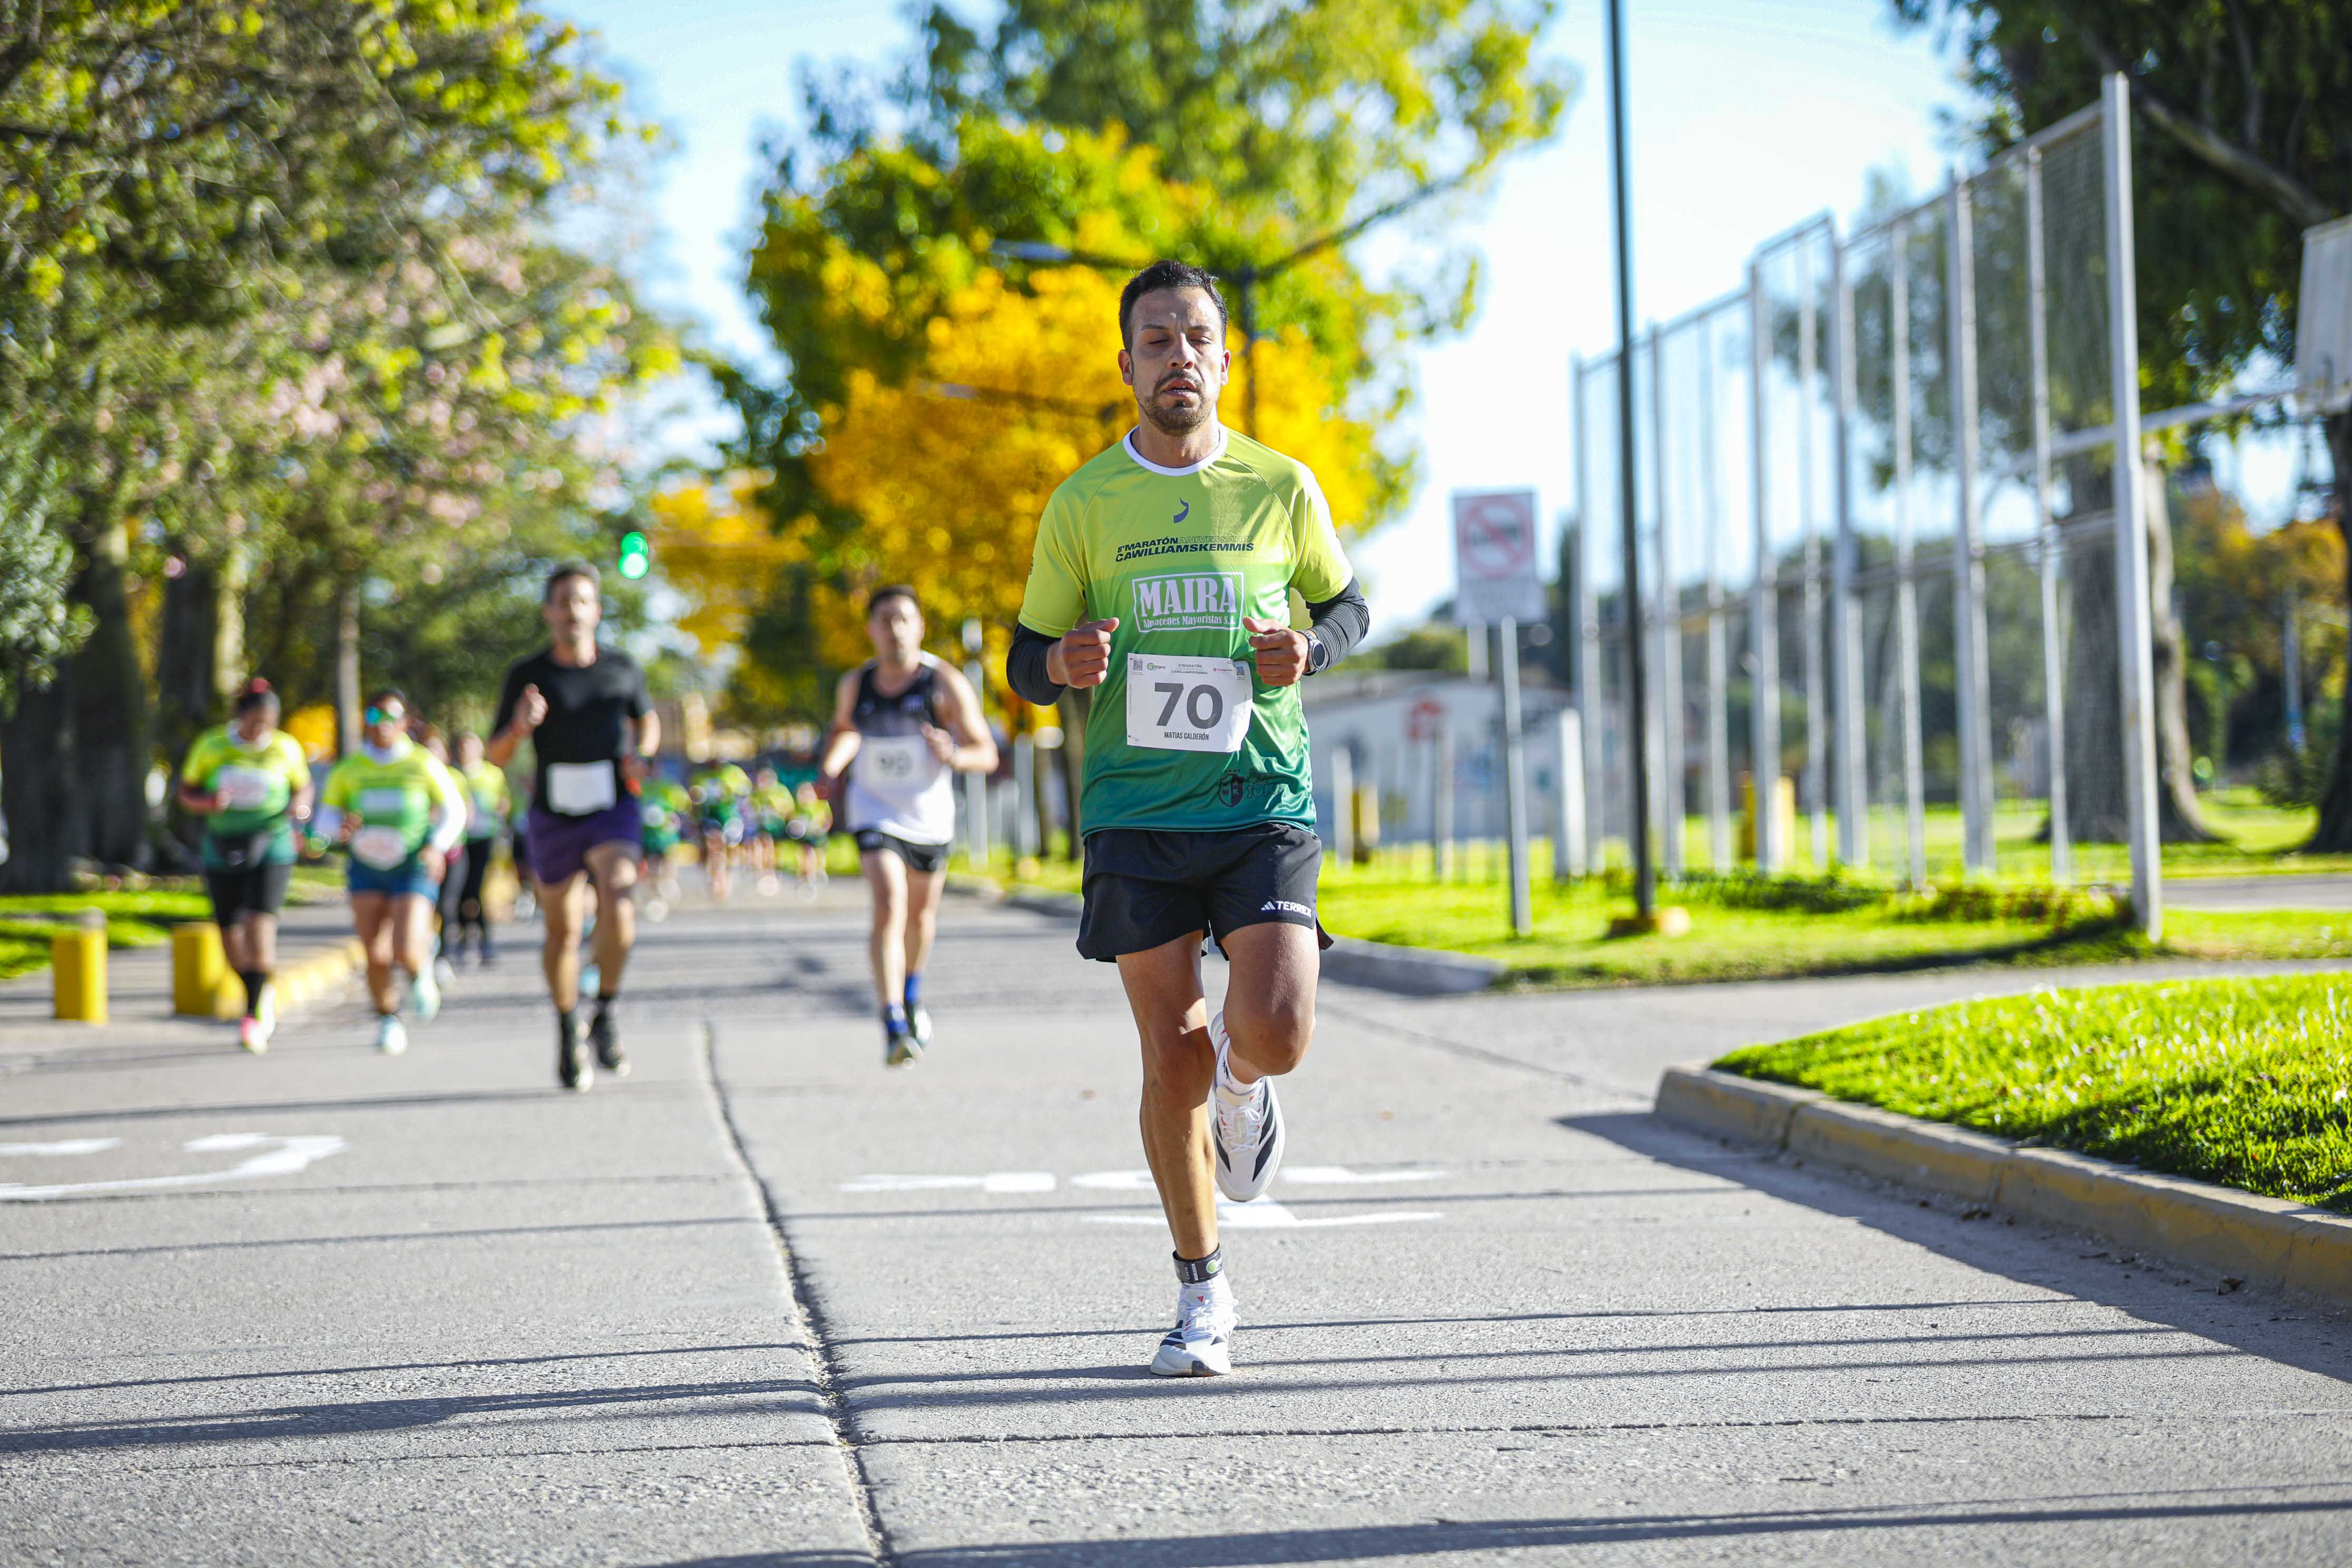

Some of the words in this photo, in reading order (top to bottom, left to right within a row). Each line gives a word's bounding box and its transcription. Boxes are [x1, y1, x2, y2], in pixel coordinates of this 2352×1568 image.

[1115, 543, 1254, 562] CAWILLIAMSKEMMIS
[1139, 577, 1237, 617] MAIRA
[1143, 616, 1180, 628] Almacenes
[1182, 614, 1222, 625] Mayoristas
[1154, 682, 1223, 729] 70
[1183, 732, 1209, 741] CALDERÓN
[1276, 900, 1312, 917] TERREX
